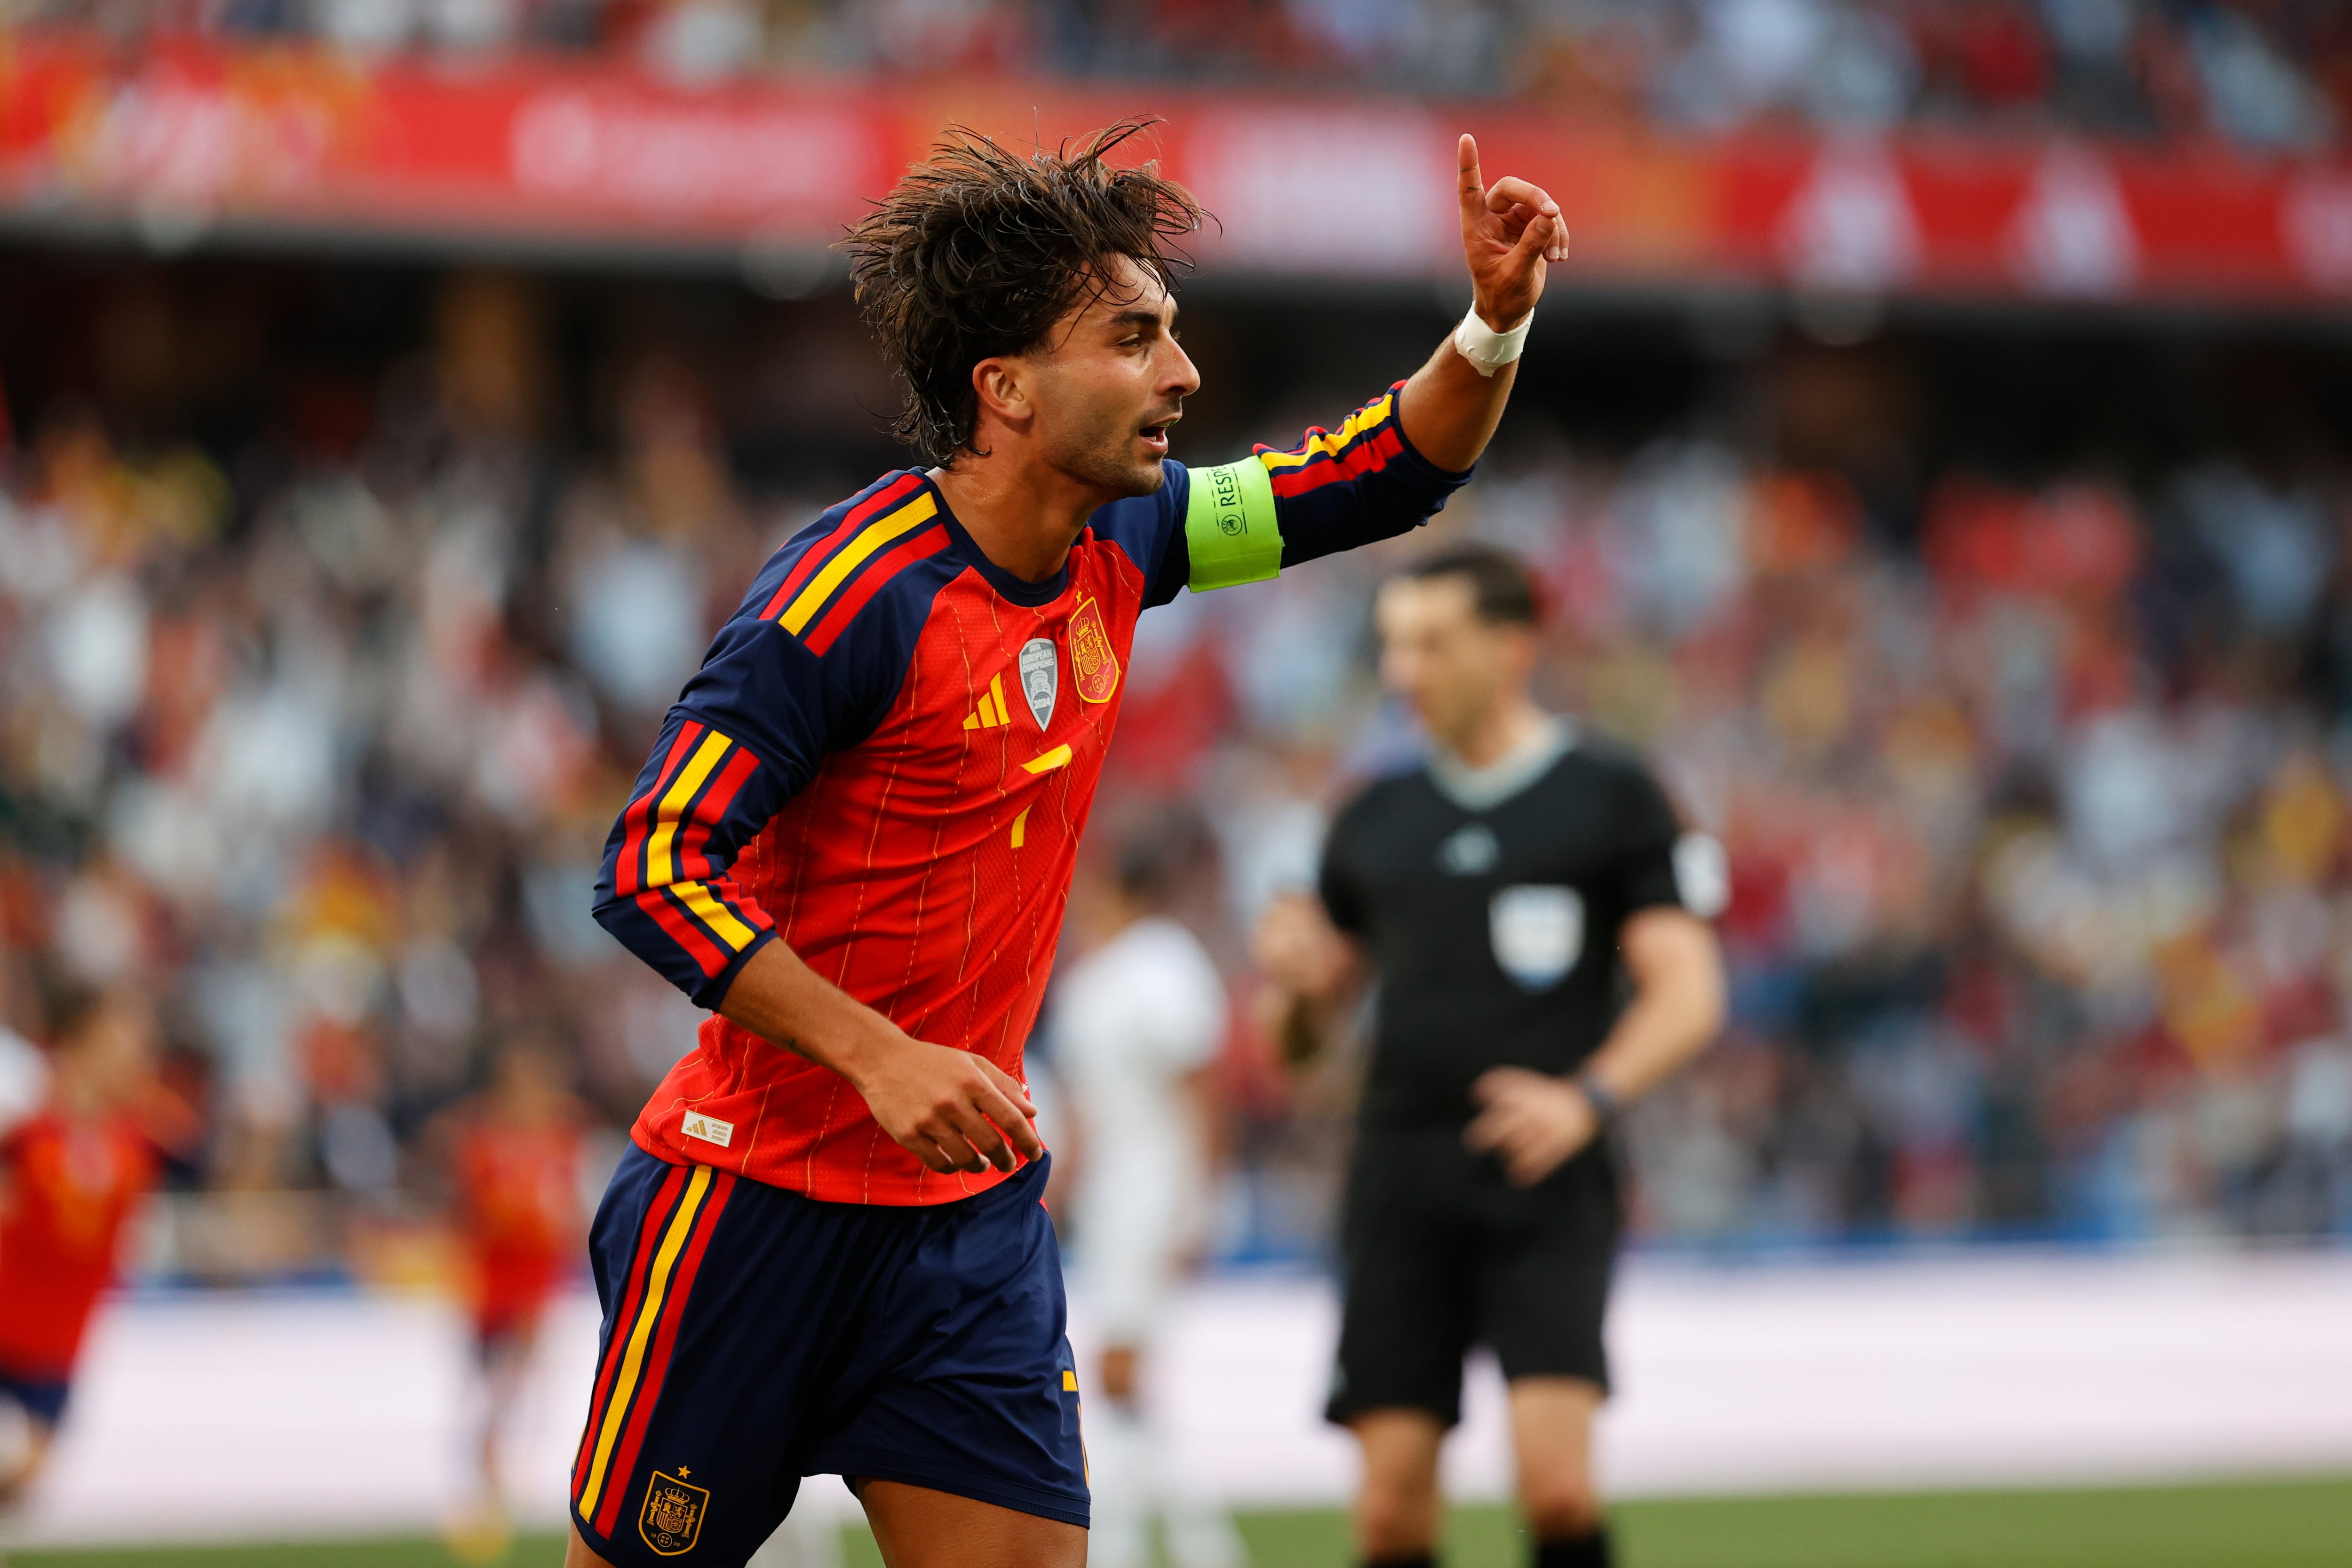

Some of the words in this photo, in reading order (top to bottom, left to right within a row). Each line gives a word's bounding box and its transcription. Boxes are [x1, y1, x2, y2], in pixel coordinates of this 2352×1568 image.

[1022, 649, 1053, 665] EUROPEAN
[1023, 658, 1054, 673] CHAMPIONS
[1033, 696, 1051, 709] 2024
